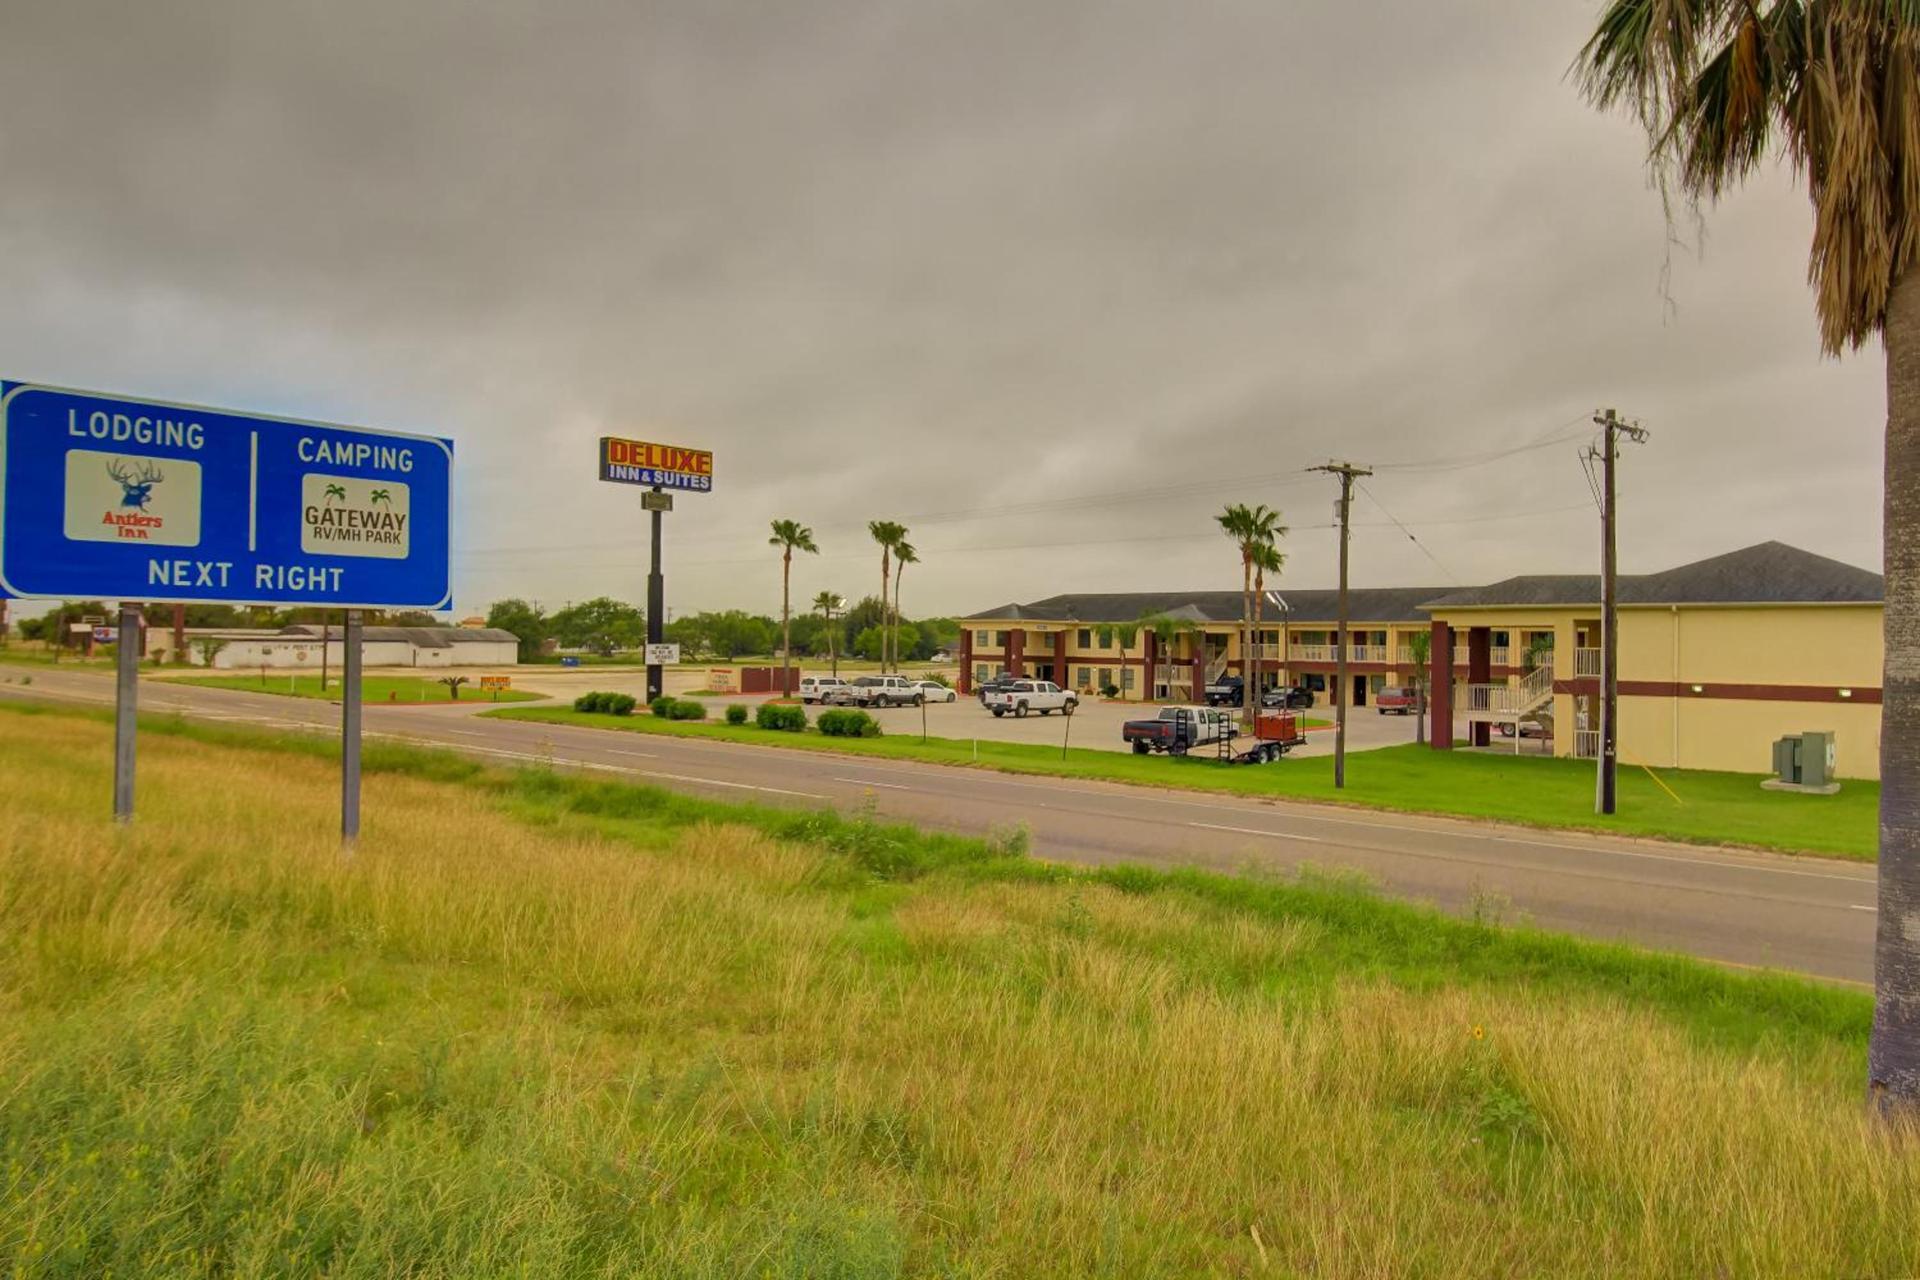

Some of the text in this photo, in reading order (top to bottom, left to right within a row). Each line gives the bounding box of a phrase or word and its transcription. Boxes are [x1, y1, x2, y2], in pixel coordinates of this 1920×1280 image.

[68, 409, 205, 450] LODGING
[298, 438, 414, 472] CAMPING
[610, 440, 710, 474] DELUXE
[609, 465, 709, 489] INN & SUITES
[102, 511, 163, 528] Antlers
[305, 505, 406, 531] GATEWAY
[117, 525, 148, 539] Inn
[313, 526, 402, 545] RV/MH PARK
[148, 559, 344, 592] NEXT RIGHT
